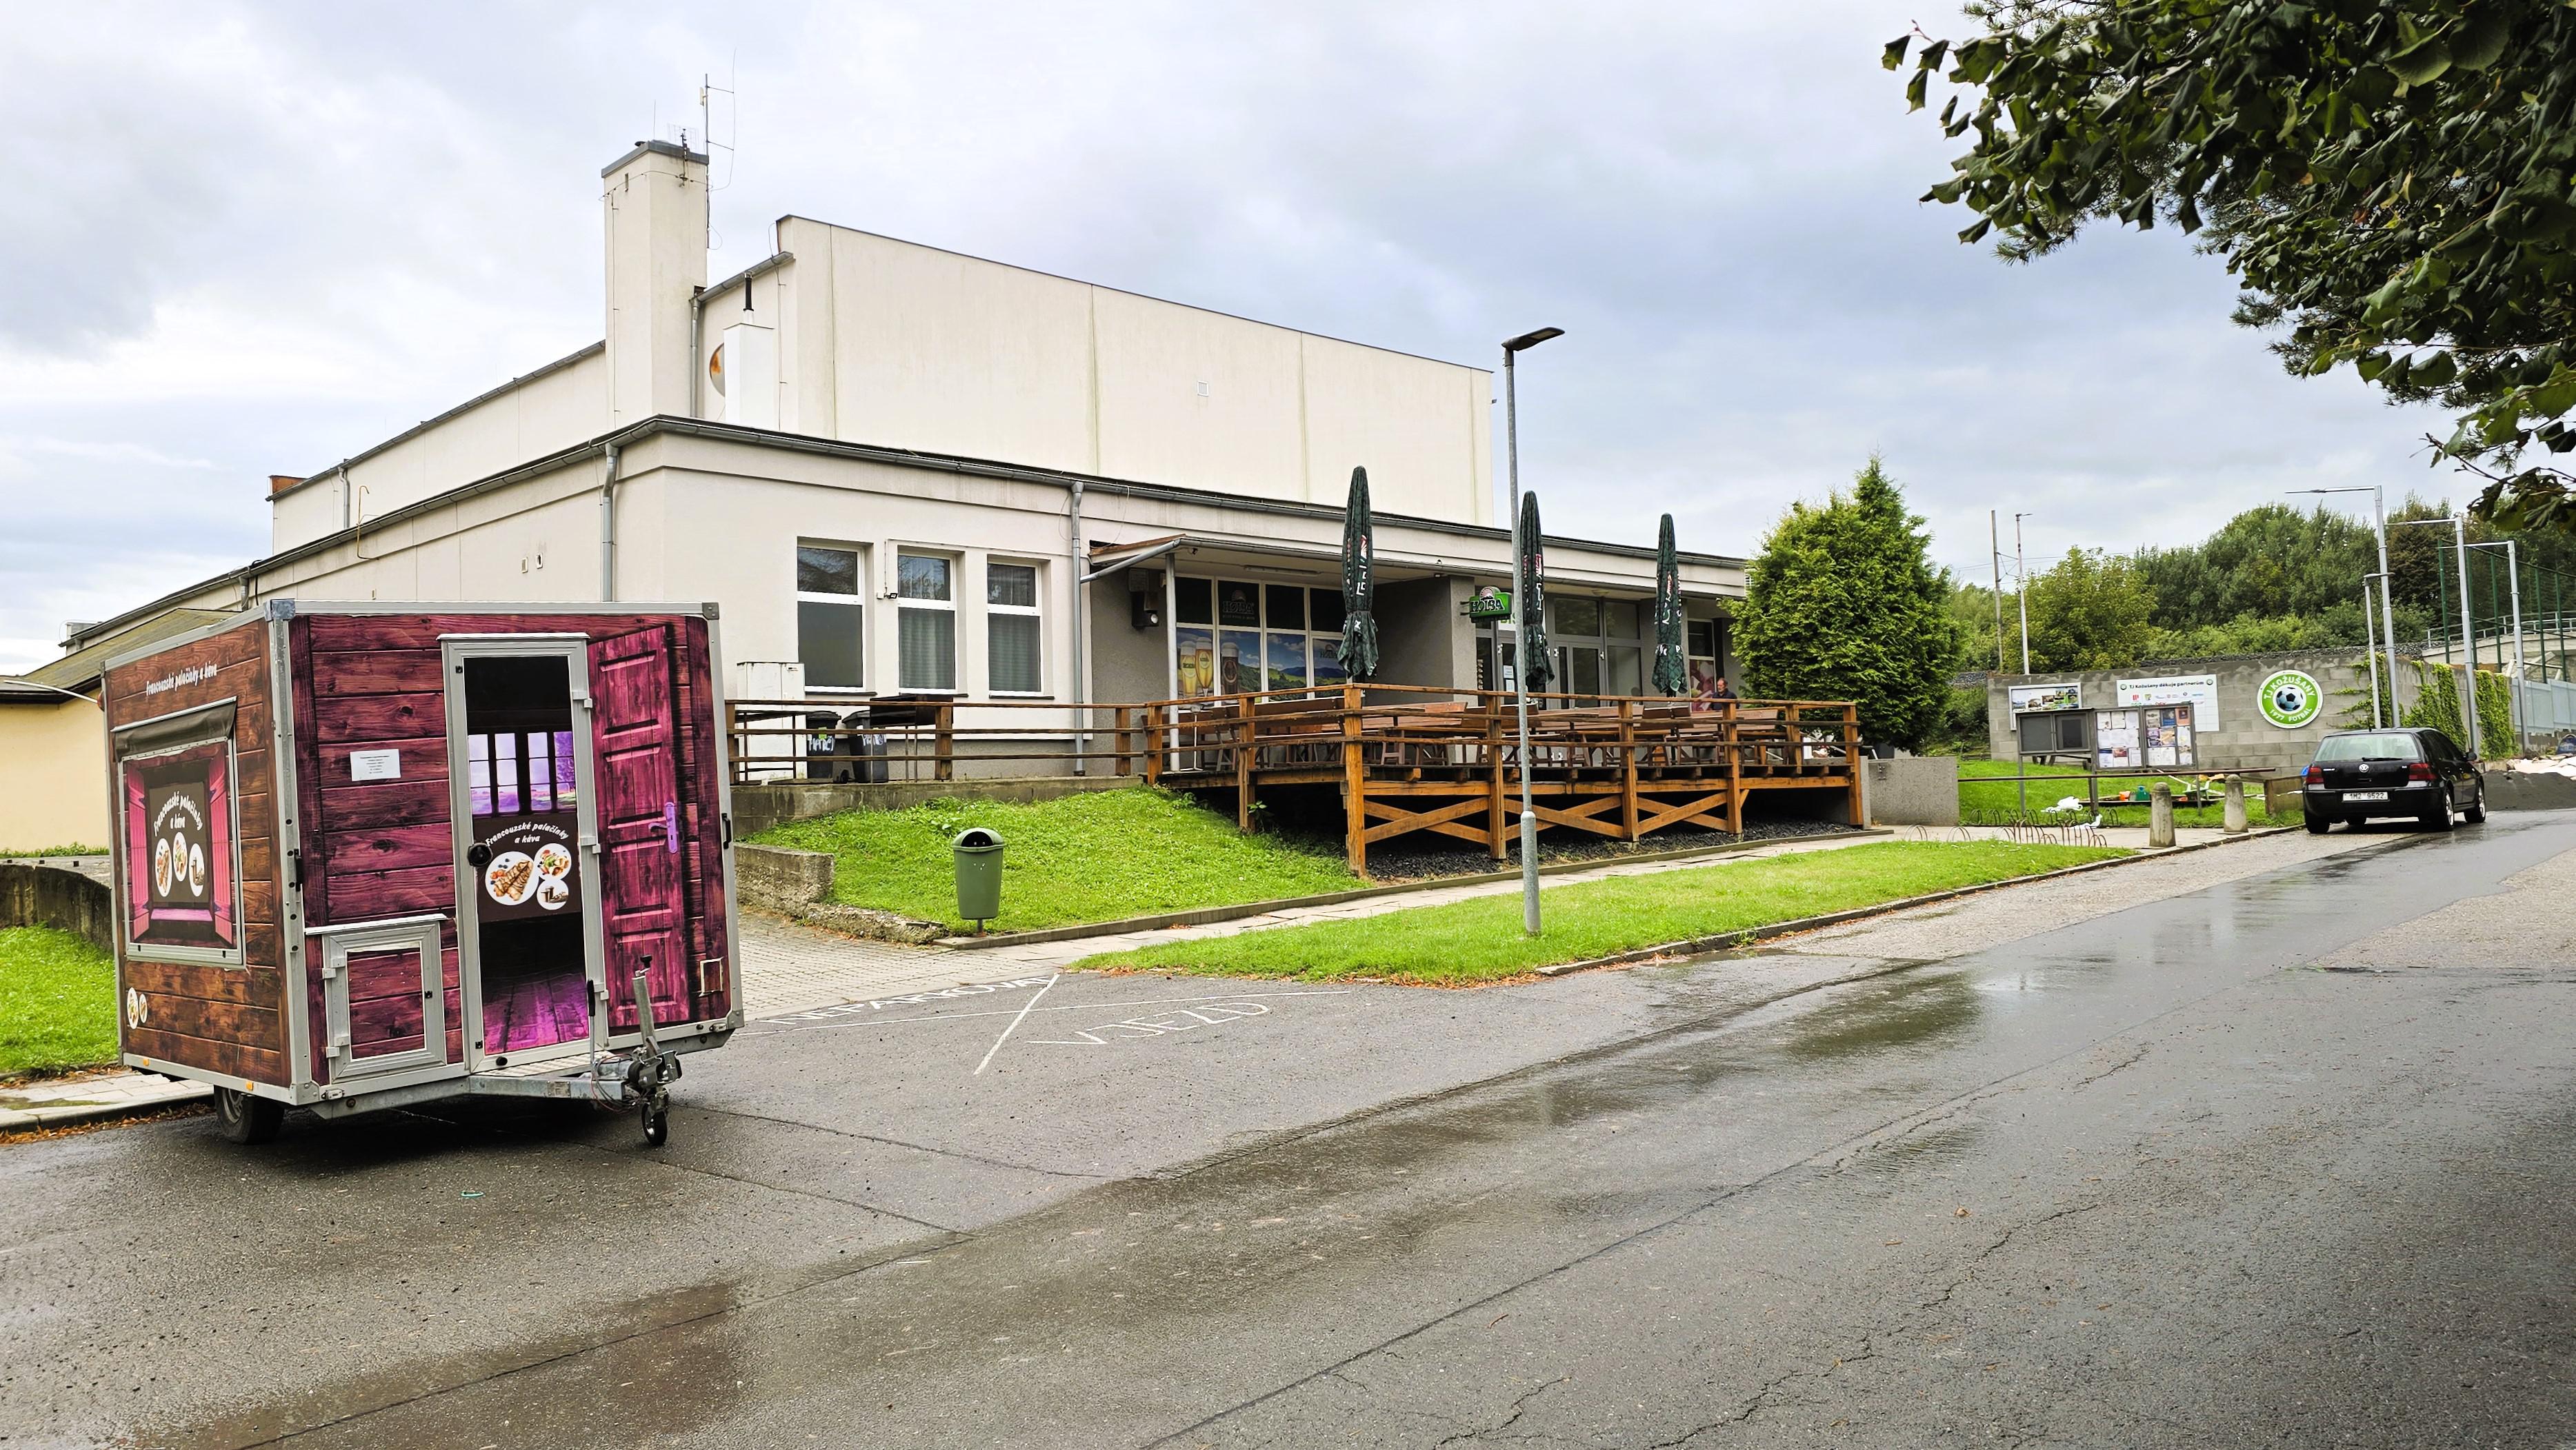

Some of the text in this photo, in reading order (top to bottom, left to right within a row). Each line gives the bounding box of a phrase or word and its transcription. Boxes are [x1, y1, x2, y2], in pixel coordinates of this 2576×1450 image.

[1470, 598, 1505, 613] HOLBA
[2264, 676, 2315, 700] TJ KOŽUŠANY
[2288, 708, 2312, 722] FOTBAL
[485, 821, 569, 847] Francouzské palačinky
[521, 834, 541, 843] káva
